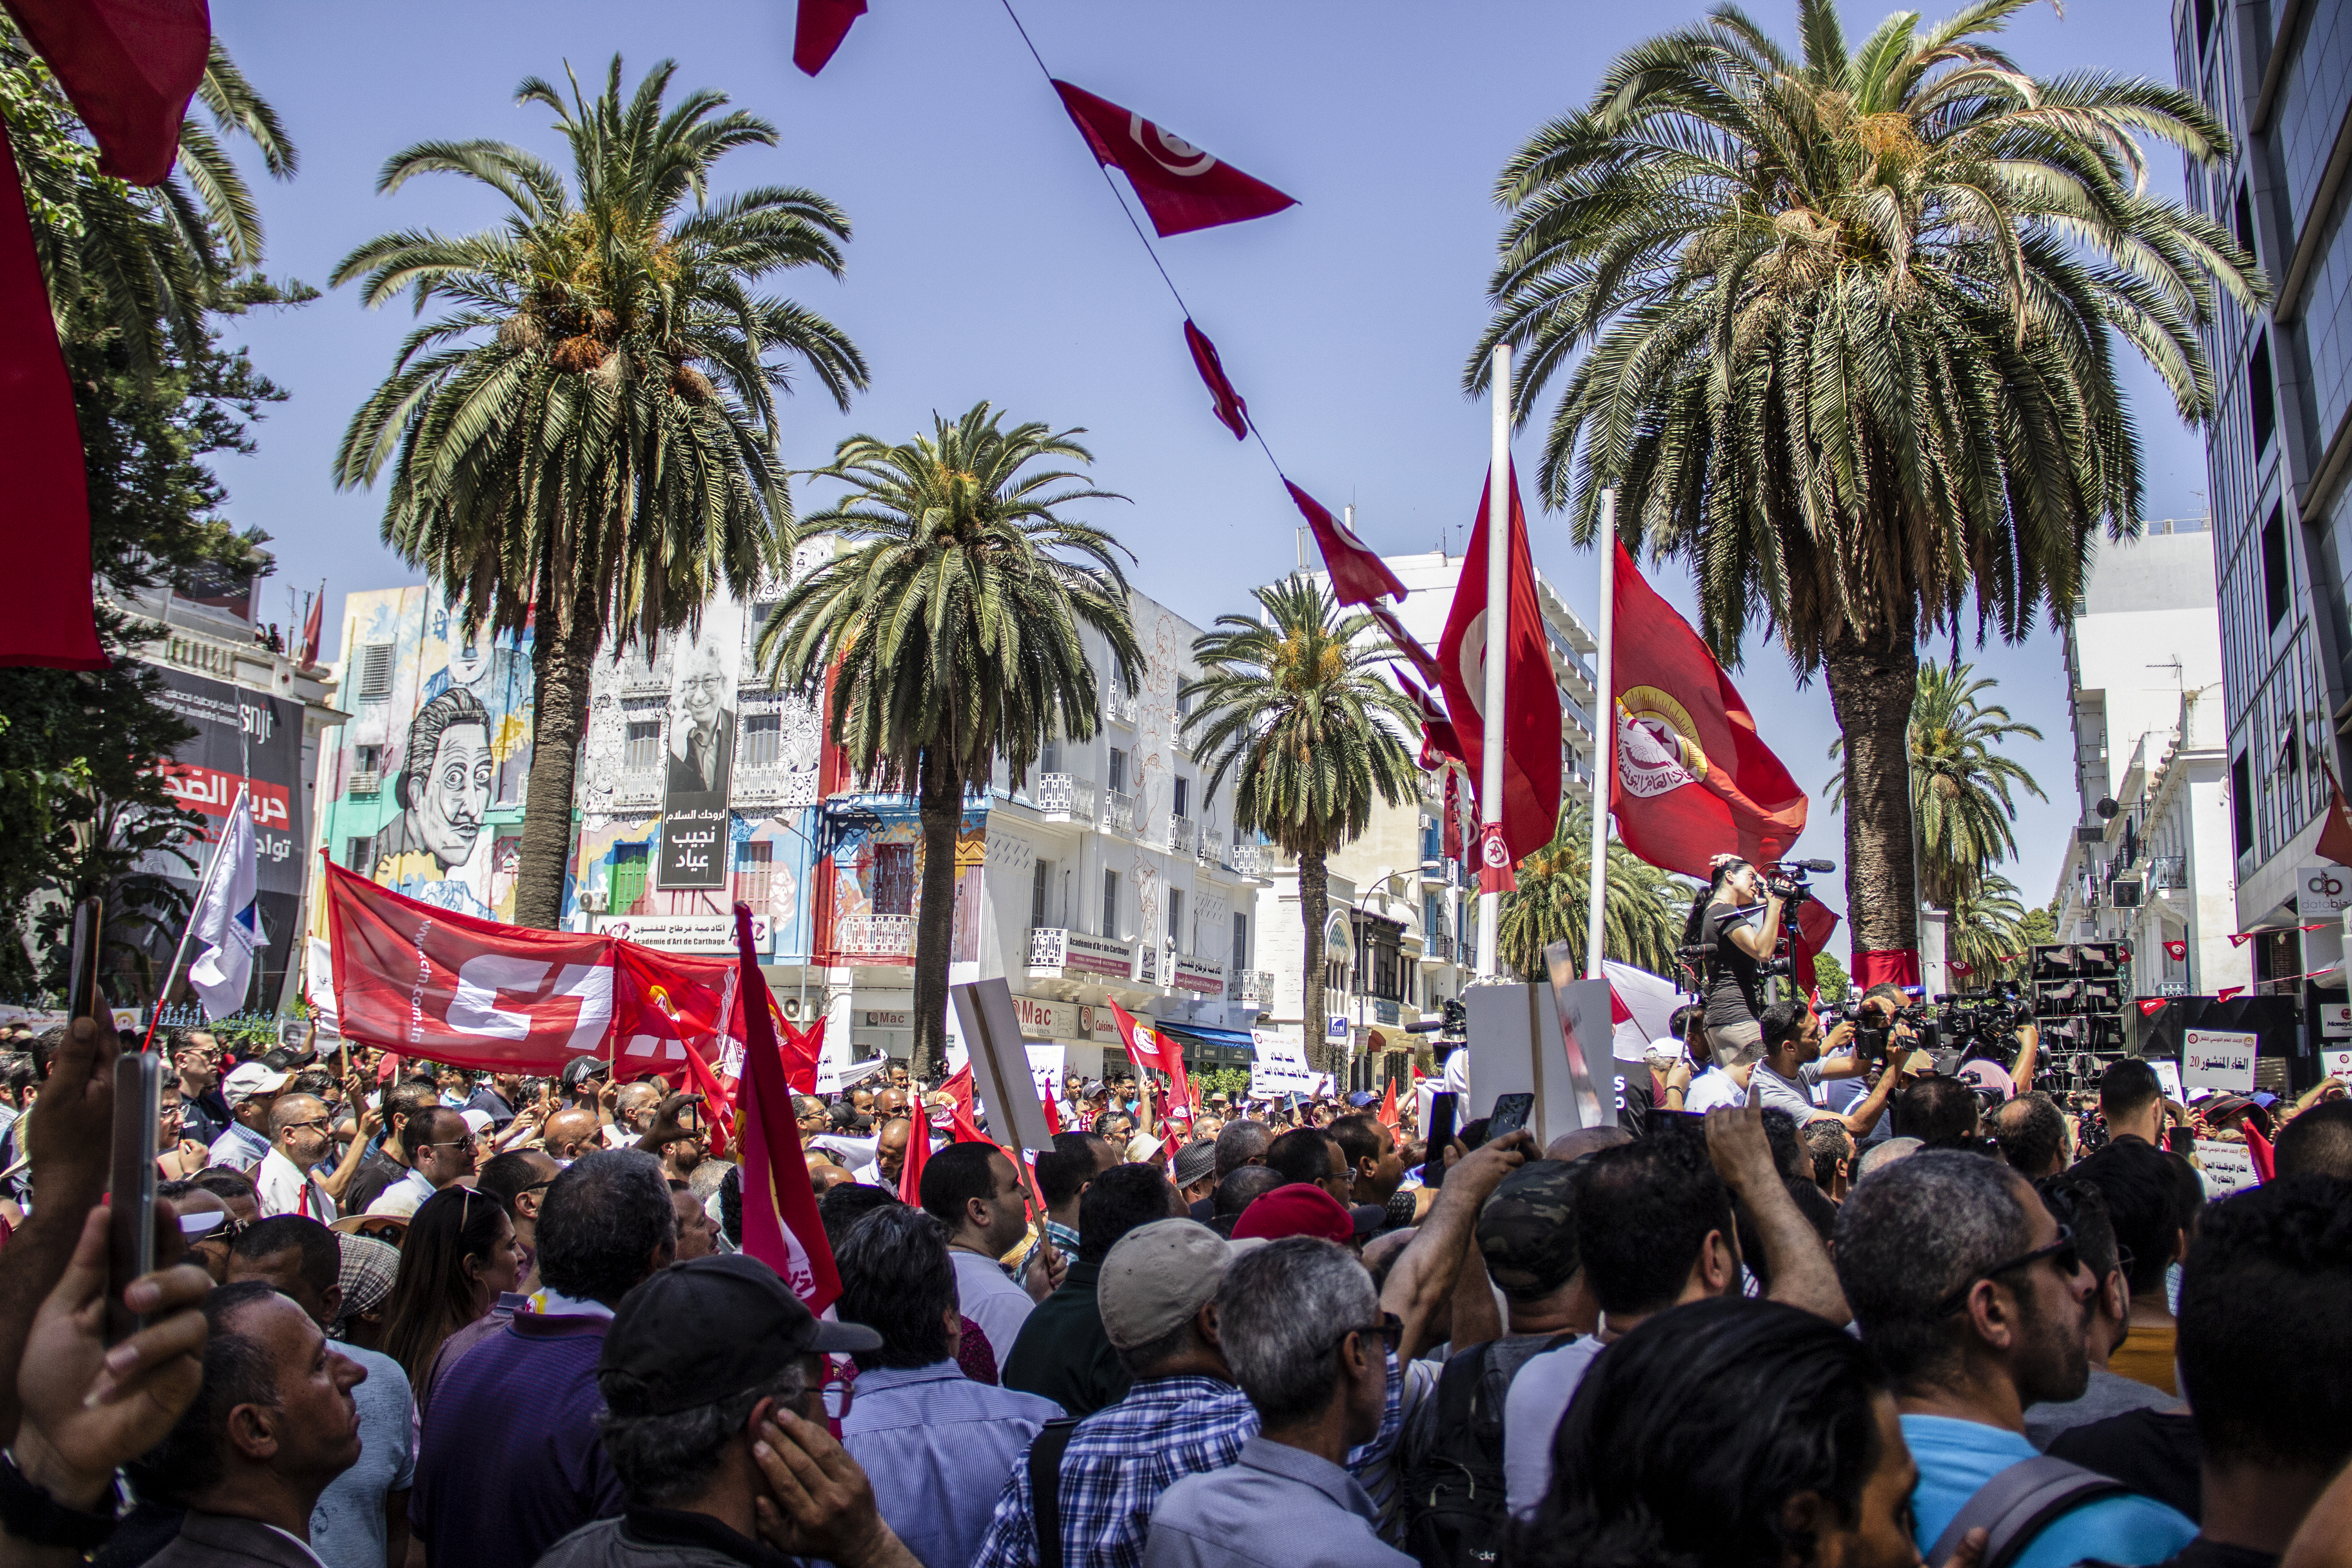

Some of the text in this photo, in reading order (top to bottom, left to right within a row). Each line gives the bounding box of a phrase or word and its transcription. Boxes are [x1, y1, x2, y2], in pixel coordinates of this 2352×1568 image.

[239, 702, 274, 745] snjt
[665, 809, 725, 824] لروحك السلام
[671, 826, 715, 848] نجيب
[675, 849, 709, 872] عياد
[669, 924, 692, 934] قرطاج
[633, 937, 666, 946] Académie
[693, 938, 725, 946] Carthage
[1069, 937, 1129, 956] Académie d'Art de Carthage
[1195, 963, 1207, 974] قرطاج
[411, 920, 432, 1043] www.ctn.com.tn
[880, 1012, 904, 1023] Mac
[1022, 1000, 1052, 1026] Mac
[1021, 1024, 1050, 1034] Cuisines
[1095, 1020, 1113, 1033] Cuisine
[2189, 1055, 2200, 1068] 20
[2330, 1066, 2343, 1078] للشغل
[2215, 1162, 2235, 1173] الوظيفة
